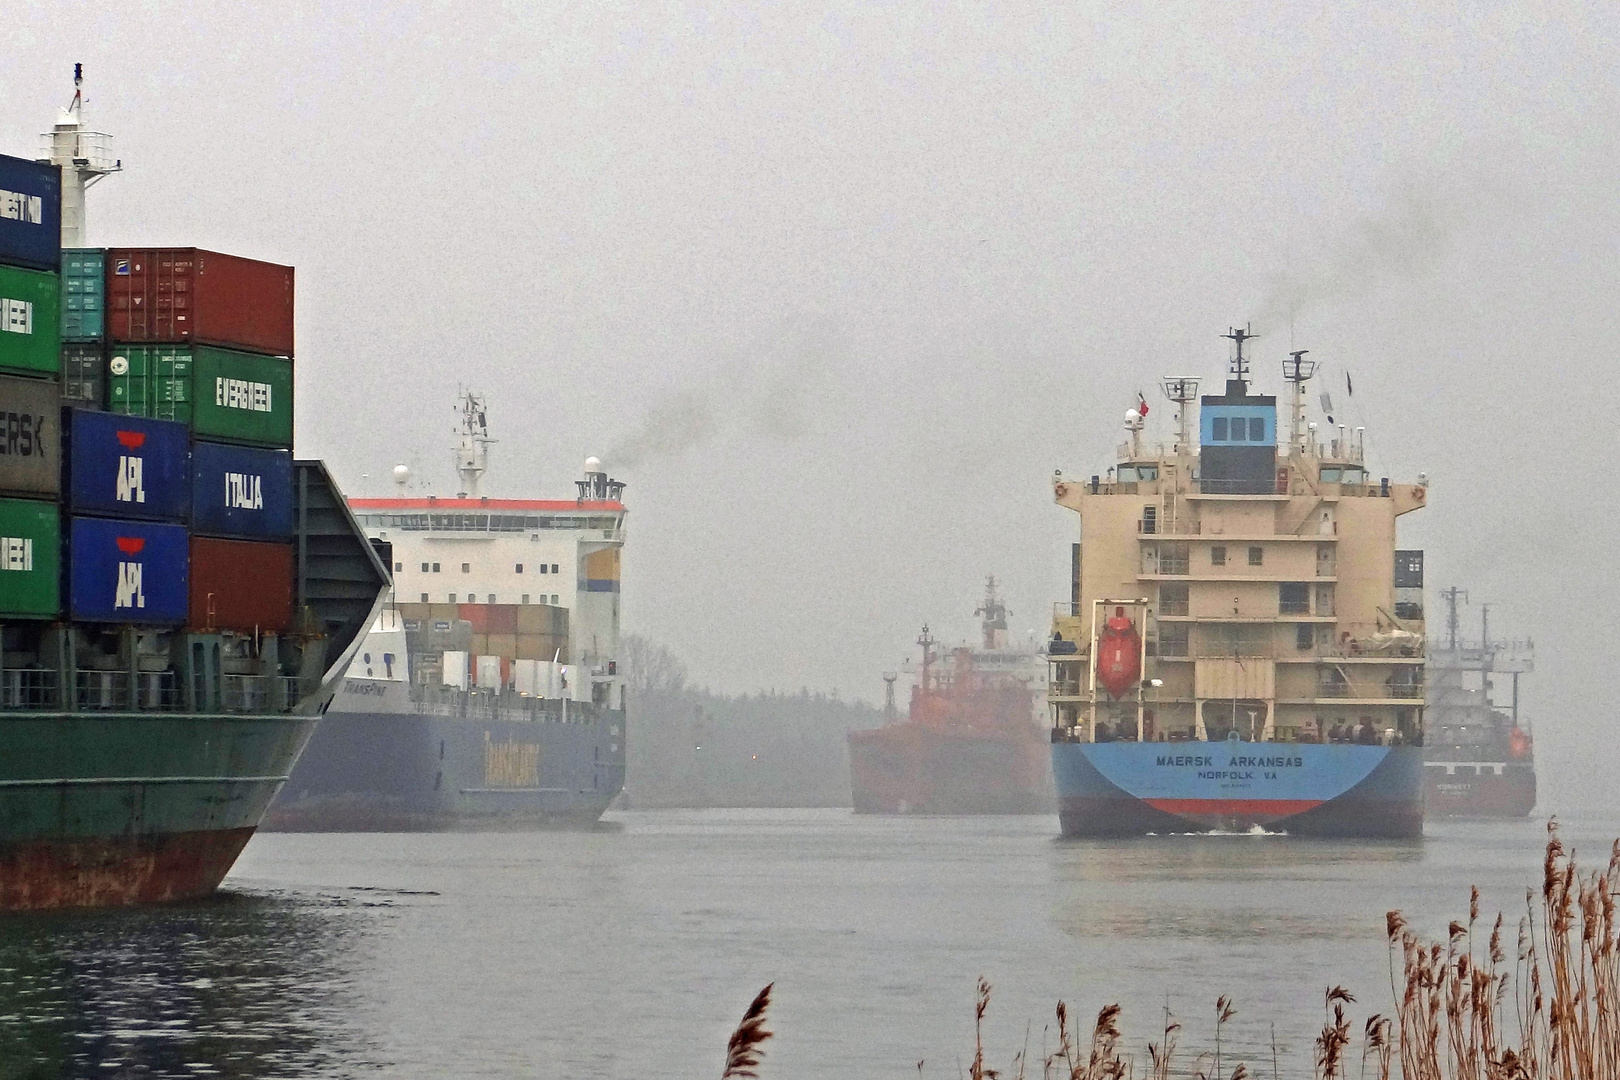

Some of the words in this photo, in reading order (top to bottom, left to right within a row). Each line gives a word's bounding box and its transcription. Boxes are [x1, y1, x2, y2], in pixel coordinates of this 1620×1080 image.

[116, 455, 145, 503] APL
[225, 472, 263, 510] ITALIA
[116, 561, 145, 608] APL
[1156, 756, 1213, 767] MAERSK
[1229, 756, 1303, 768] ARKANSAS
[1197, 771, 1253, 780] NORFOLK
